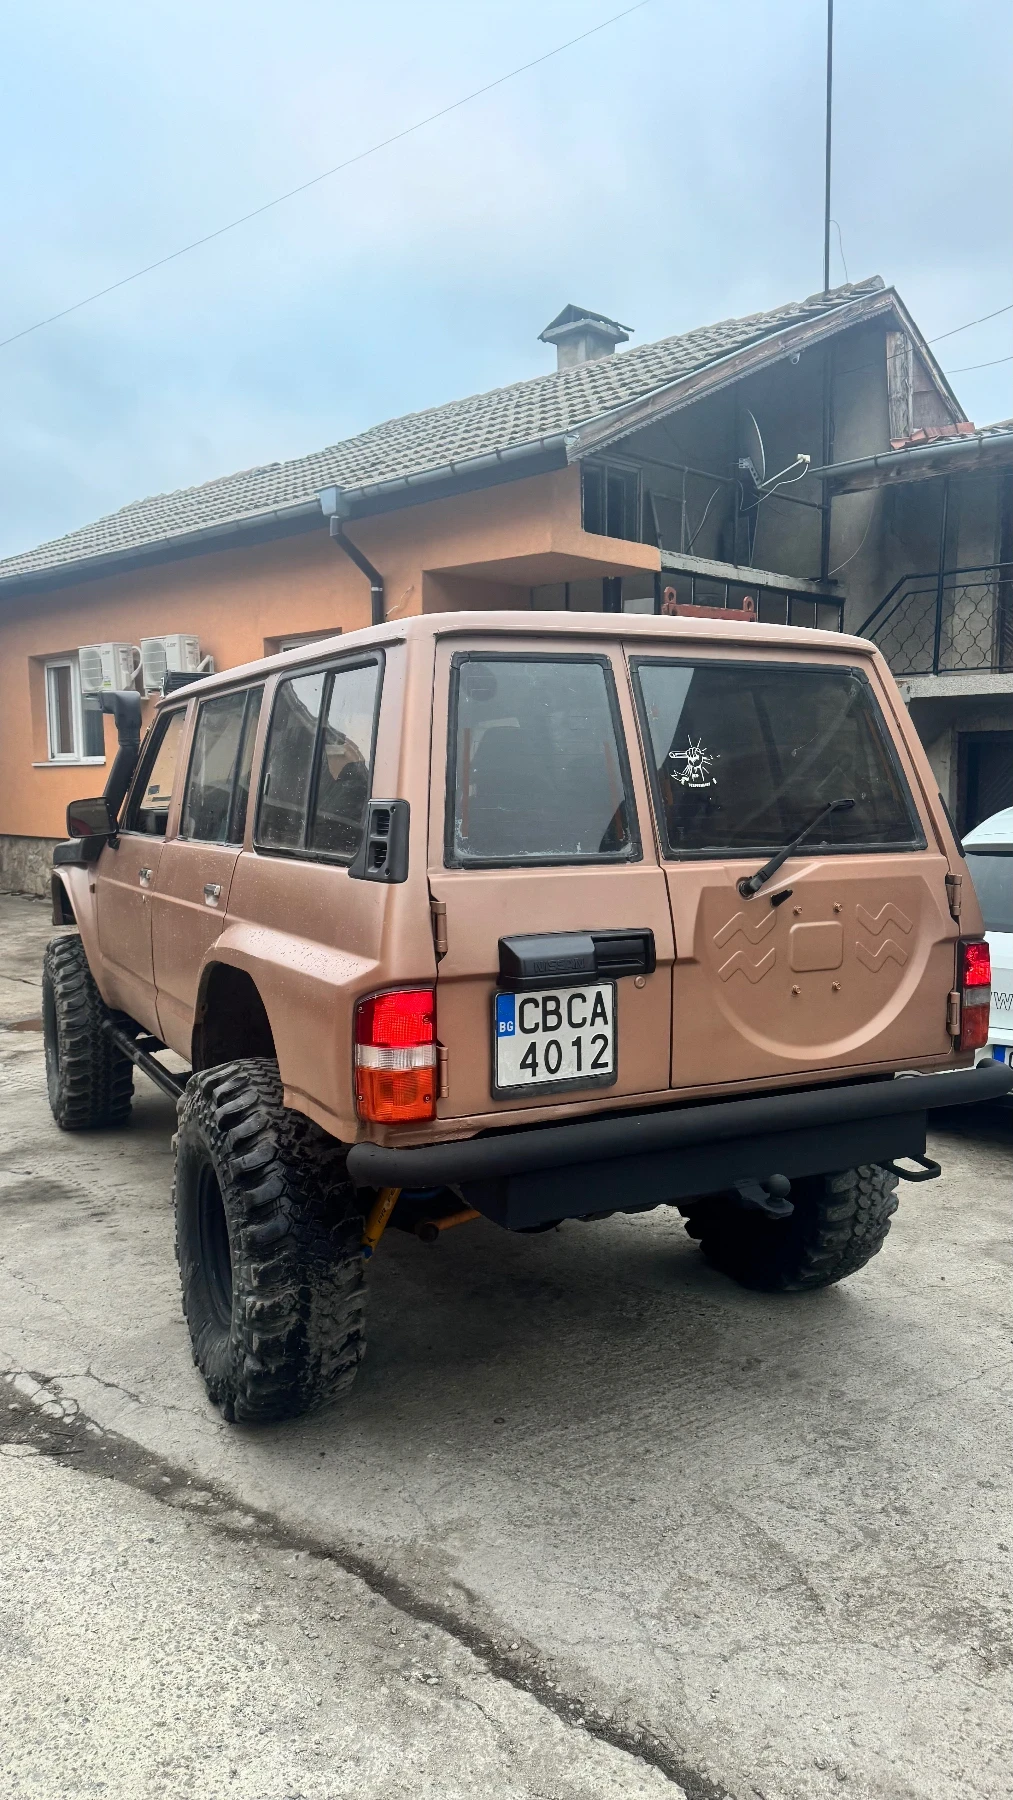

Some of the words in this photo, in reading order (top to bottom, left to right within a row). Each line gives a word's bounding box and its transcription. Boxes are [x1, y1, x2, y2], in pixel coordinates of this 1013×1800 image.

[499, 1021, 514, 1033] BG
[519, 990, 609, 1035] CBCA
[519, 1034, 609, 1077] 4012
